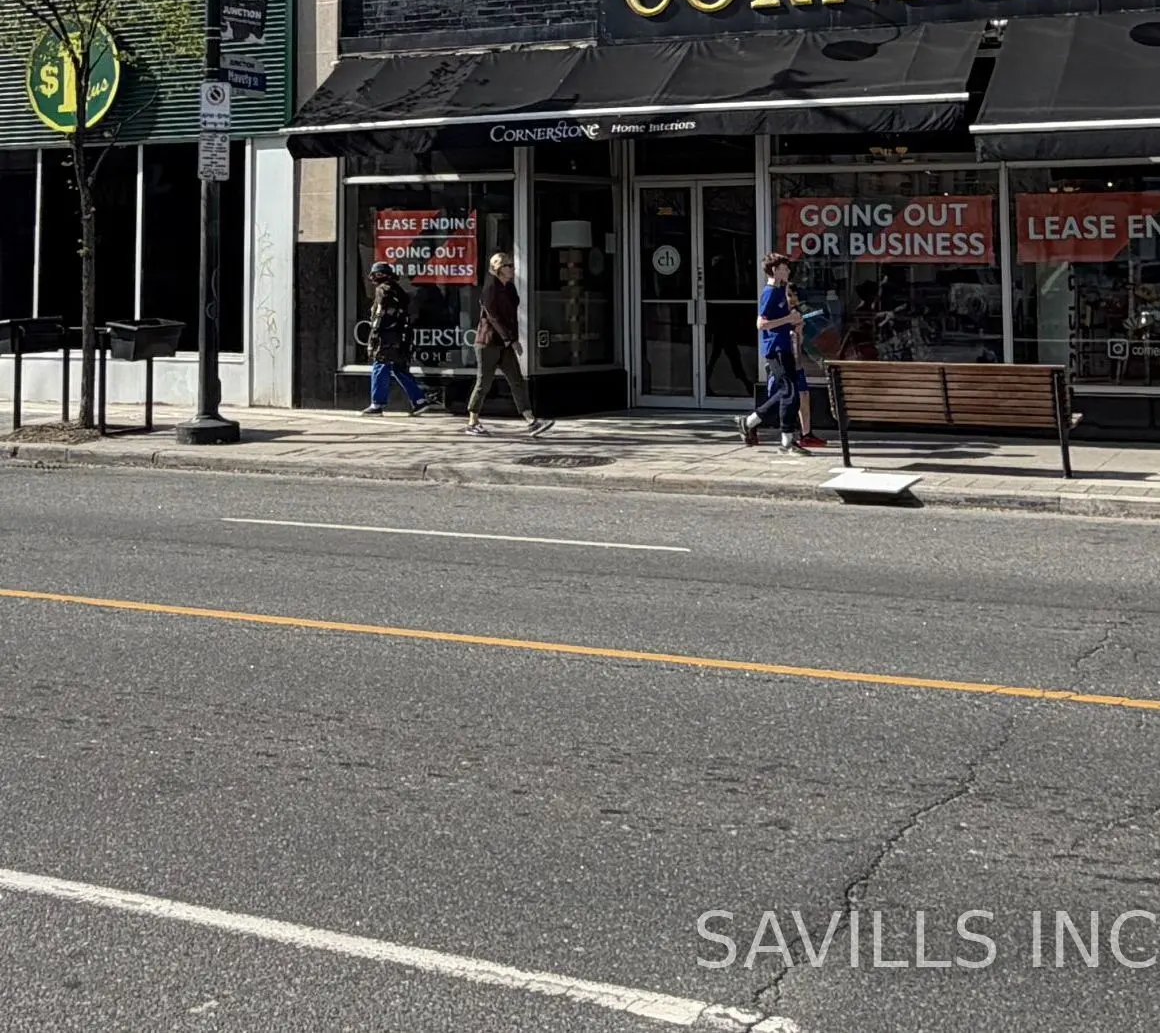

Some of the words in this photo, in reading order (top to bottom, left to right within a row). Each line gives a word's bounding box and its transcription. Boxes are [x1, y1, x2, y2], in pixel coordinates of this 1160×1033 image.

[611, 123, 645, 134] Home
[649, 120, 696, 132] Interiors
[800, 204, 893, 227] GOING
[904, 203, 968, 227] OUT
[377, 218, 417, 230] LEASE
[421, 218, 476, 230] ENDING
[1028, 216, 1116, 240] LEASE
[786, 233, 840, 256] FOR
[850, 232, 985, 256] BUSINESS
[385, 246, 431, 259] GOING
[435, 246, 466, 258] OUT
[657, 250, 675, 267] ch
[408, 264, 474, 276] BUSINESS
